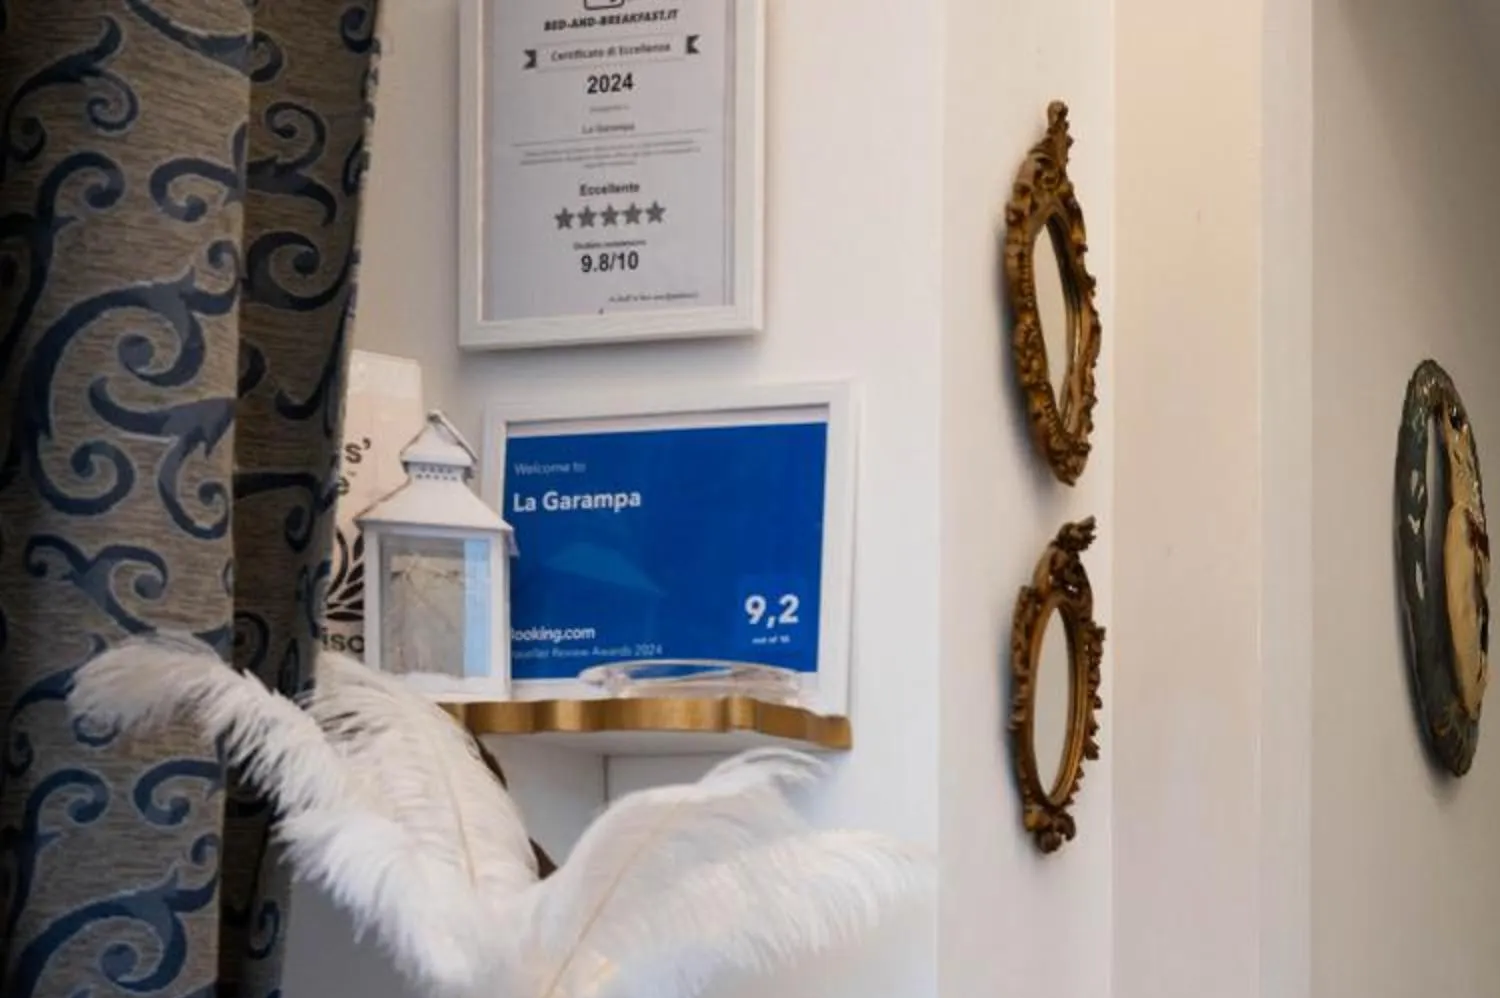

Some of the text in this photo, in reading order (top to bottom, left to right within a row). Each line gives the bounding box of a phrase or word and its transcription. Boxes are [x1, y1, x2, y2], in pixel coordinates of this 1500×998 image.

[586, 72, 635, 94] 2024
[579, 183, 640, 197] Eccellente
[580, 251, 639, 273] 9.8/10
[514, 461, 587, 475] Welcome to
[513, 490, 642, 513] La Garampa
[745, 594, 800, 629] 9,2
[511, 625, 595, 643] ooking.com
[634, 643, 663, 657] 2024
